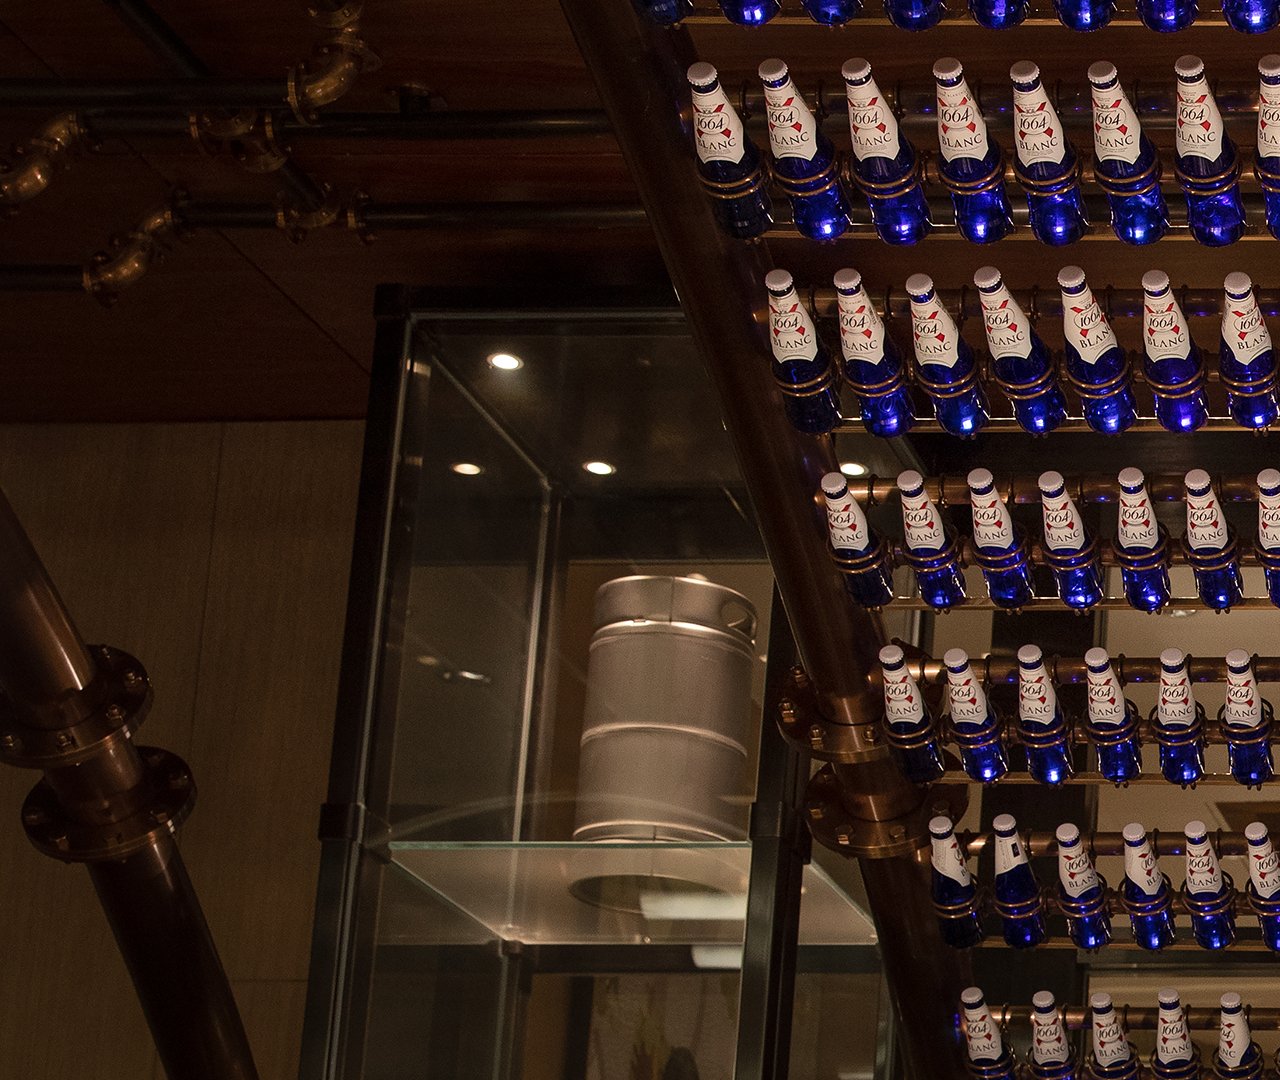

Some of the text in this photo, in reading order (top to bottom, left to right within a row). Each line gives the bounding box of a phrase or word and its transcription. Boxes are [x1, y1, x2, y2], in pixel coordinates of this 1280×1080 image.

[941, 108, 971, 122] 1664
[941, 134, 982, 148] BLANC
[774, 316, 798, 329] 1664
[773, 335, 811, 349] BLANC
[1160, 705, 1193, 718] BLANC
